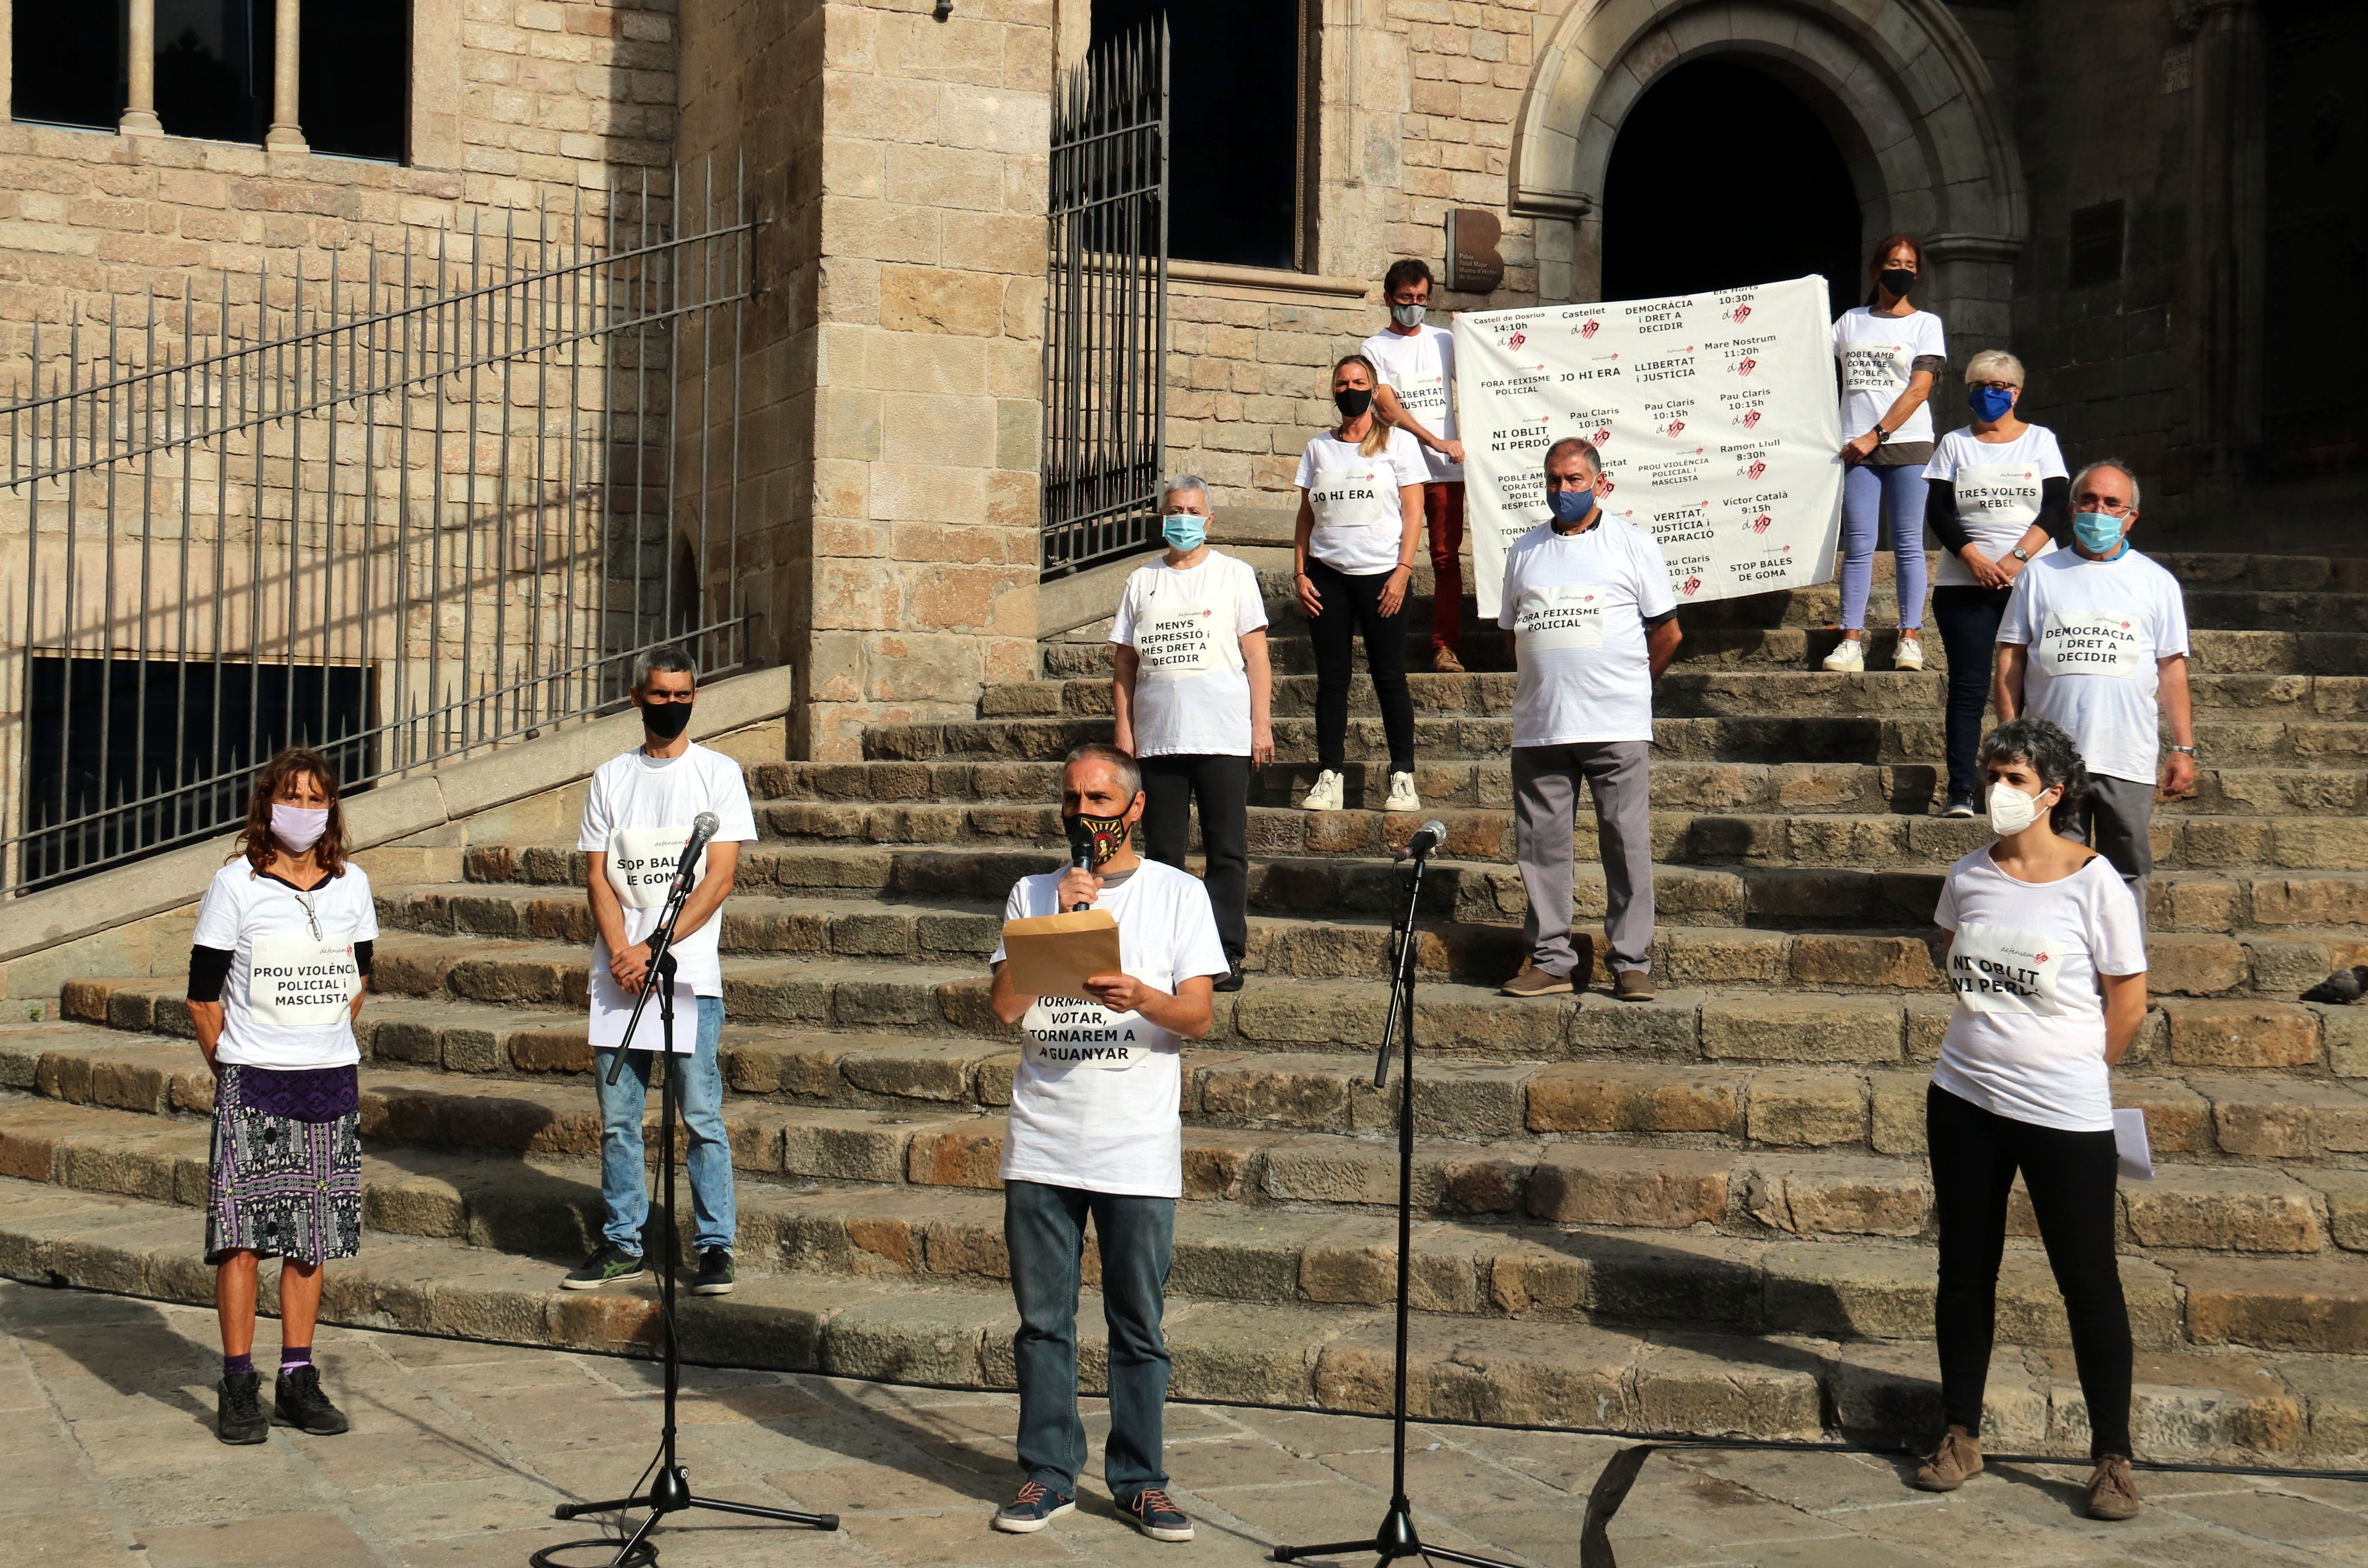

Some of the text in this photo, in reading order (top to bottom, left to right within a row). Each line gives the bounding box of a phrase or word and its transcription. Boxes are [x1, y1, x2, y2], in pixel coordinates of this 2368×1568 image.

[1719, 294, 1754, 304] 10:30h
[1562, 307, 1605, 319] Castellet
[1625, 300, 1693, 315] DEMOCRÀCIA
[1515, 311, 1545, 320] Dosrius
[1645, 313, 1671, 323] DRET
[1722, 309, 1732, 320] d
[1494, 322, 1528, 333] 14:10h
[1571, 326, 1580, 335] d
[1639, 321, 1683, 334] DECIDIR
[1497, 338, 1507, 346] d
[1704, 334, 1776, 350] Mare Nostrum
[1724, 347, 1759, 357] 11:20h
[1635, 357, 1695, 371] LLIBERTAT
[1727, 364, 1737, 373] d
[1560, 368, 1620, 382] JO HI ERA
[1643, 368, 1696, 382] JUSTÍCIA
[1508, 376, 1550, 386] FEIXISME
[1496, 386, 1538, 395] POLICIAL
[1742, 388, 1770, 399] Claris
[1666, 399, 1695, 408] Claris
[1729, 400, 1764, 410] 10:15h
[1591, 407, 1619, 416] Claris
[1653, 410, 1688, 420] 10:15h
[1579, 418, 1612, 428] 10:15h
[1732, 415, 1742, 425] d
[1493, 426, 1548, 439] NI OBLIT
[1656, 425, 1666, 434] d
[1492, 434, 1550, 451] NI PERDÓ
[1721, 439, 1780, 453] Ramon Llull
[1736, 451, 1765, 461] 8:30h
[1600, 459, 1627, 468] eritat
[1663, 457, 1709, 468] VIOLÈNCIA
[1652, 469, 1691, 478] POLICIAL
[1737, 467, 1747, 476] d
[1498, 474, 1527, 482] POBLE
[1652, 475, 1698, 486] MASCLISTA
[1502, 482, 1547, 491] CORATGE,
[1313, 490, 1374, 503] JO HI ERA
[1723, 491, 1788, 506] Víctor Català
[1958, 488, 2036, 498] TRES VOLTES
[1502, 500, 1546, 510] RESPECTA
[1742, 504, 1771, 514] 9:15h
[1979, 499, 2014, 508] REBEL
[1653, 508, 1705, 522] VERITAT,
[1651, 520, 1703, 534] JUSTÍCIA
[1742, 520, 1752, 530] d
[1657, 528, 1714, 544] EPARACIÓ
[1682, 555, 1710, 564] Claris
[1730, 557, 1793, 572] STOP BALES
[1669, 566, 1703, 576] 10:15h
[1739, 569, 1786, 581] DE GOMA
[1672, 581, 1681, 592] d
[1516, 608, 1600, 624] FORA FEIXISME
[2094, 616, 2121, 625] defensem
[1156, 620, 1194, 630] MENYS
[1528, 619, 1581, 632] POLICIAL
[1141, 628, 1203, 644] REPRESSIÓ
[2045, 625, 2135, 641] DEMOCRÀCIA
[1142, 644, 1163, 656] MÉS
[1167, 643, 1195, 653] DRET
[2059, 641, 2062, 649] i
[2068, 640, 2103, 648] DRET
[1153, 654, 1199, 666] DECIDIR
[2058, 652, 2116, 664] DECIDIR
[650, 856, 680, 868] BAL
[644, 872, 676, 884] GOM
[2000, 946, 2034, 958] defensem
[254, 962, 356, 977] PROU VIOLÈNCIA
[1953, 955, 2039, 985] NI OBLIT
[278, 979, 346, 991] POLICIAL i
[1953, 978, 1973, 992] NI
[275, 994, 348, 1006] MASCLISTA
[1052, 1012, 1108, 1026] VOTAR,
[1029, 1029, 1135, 1042] TORNAREM A
